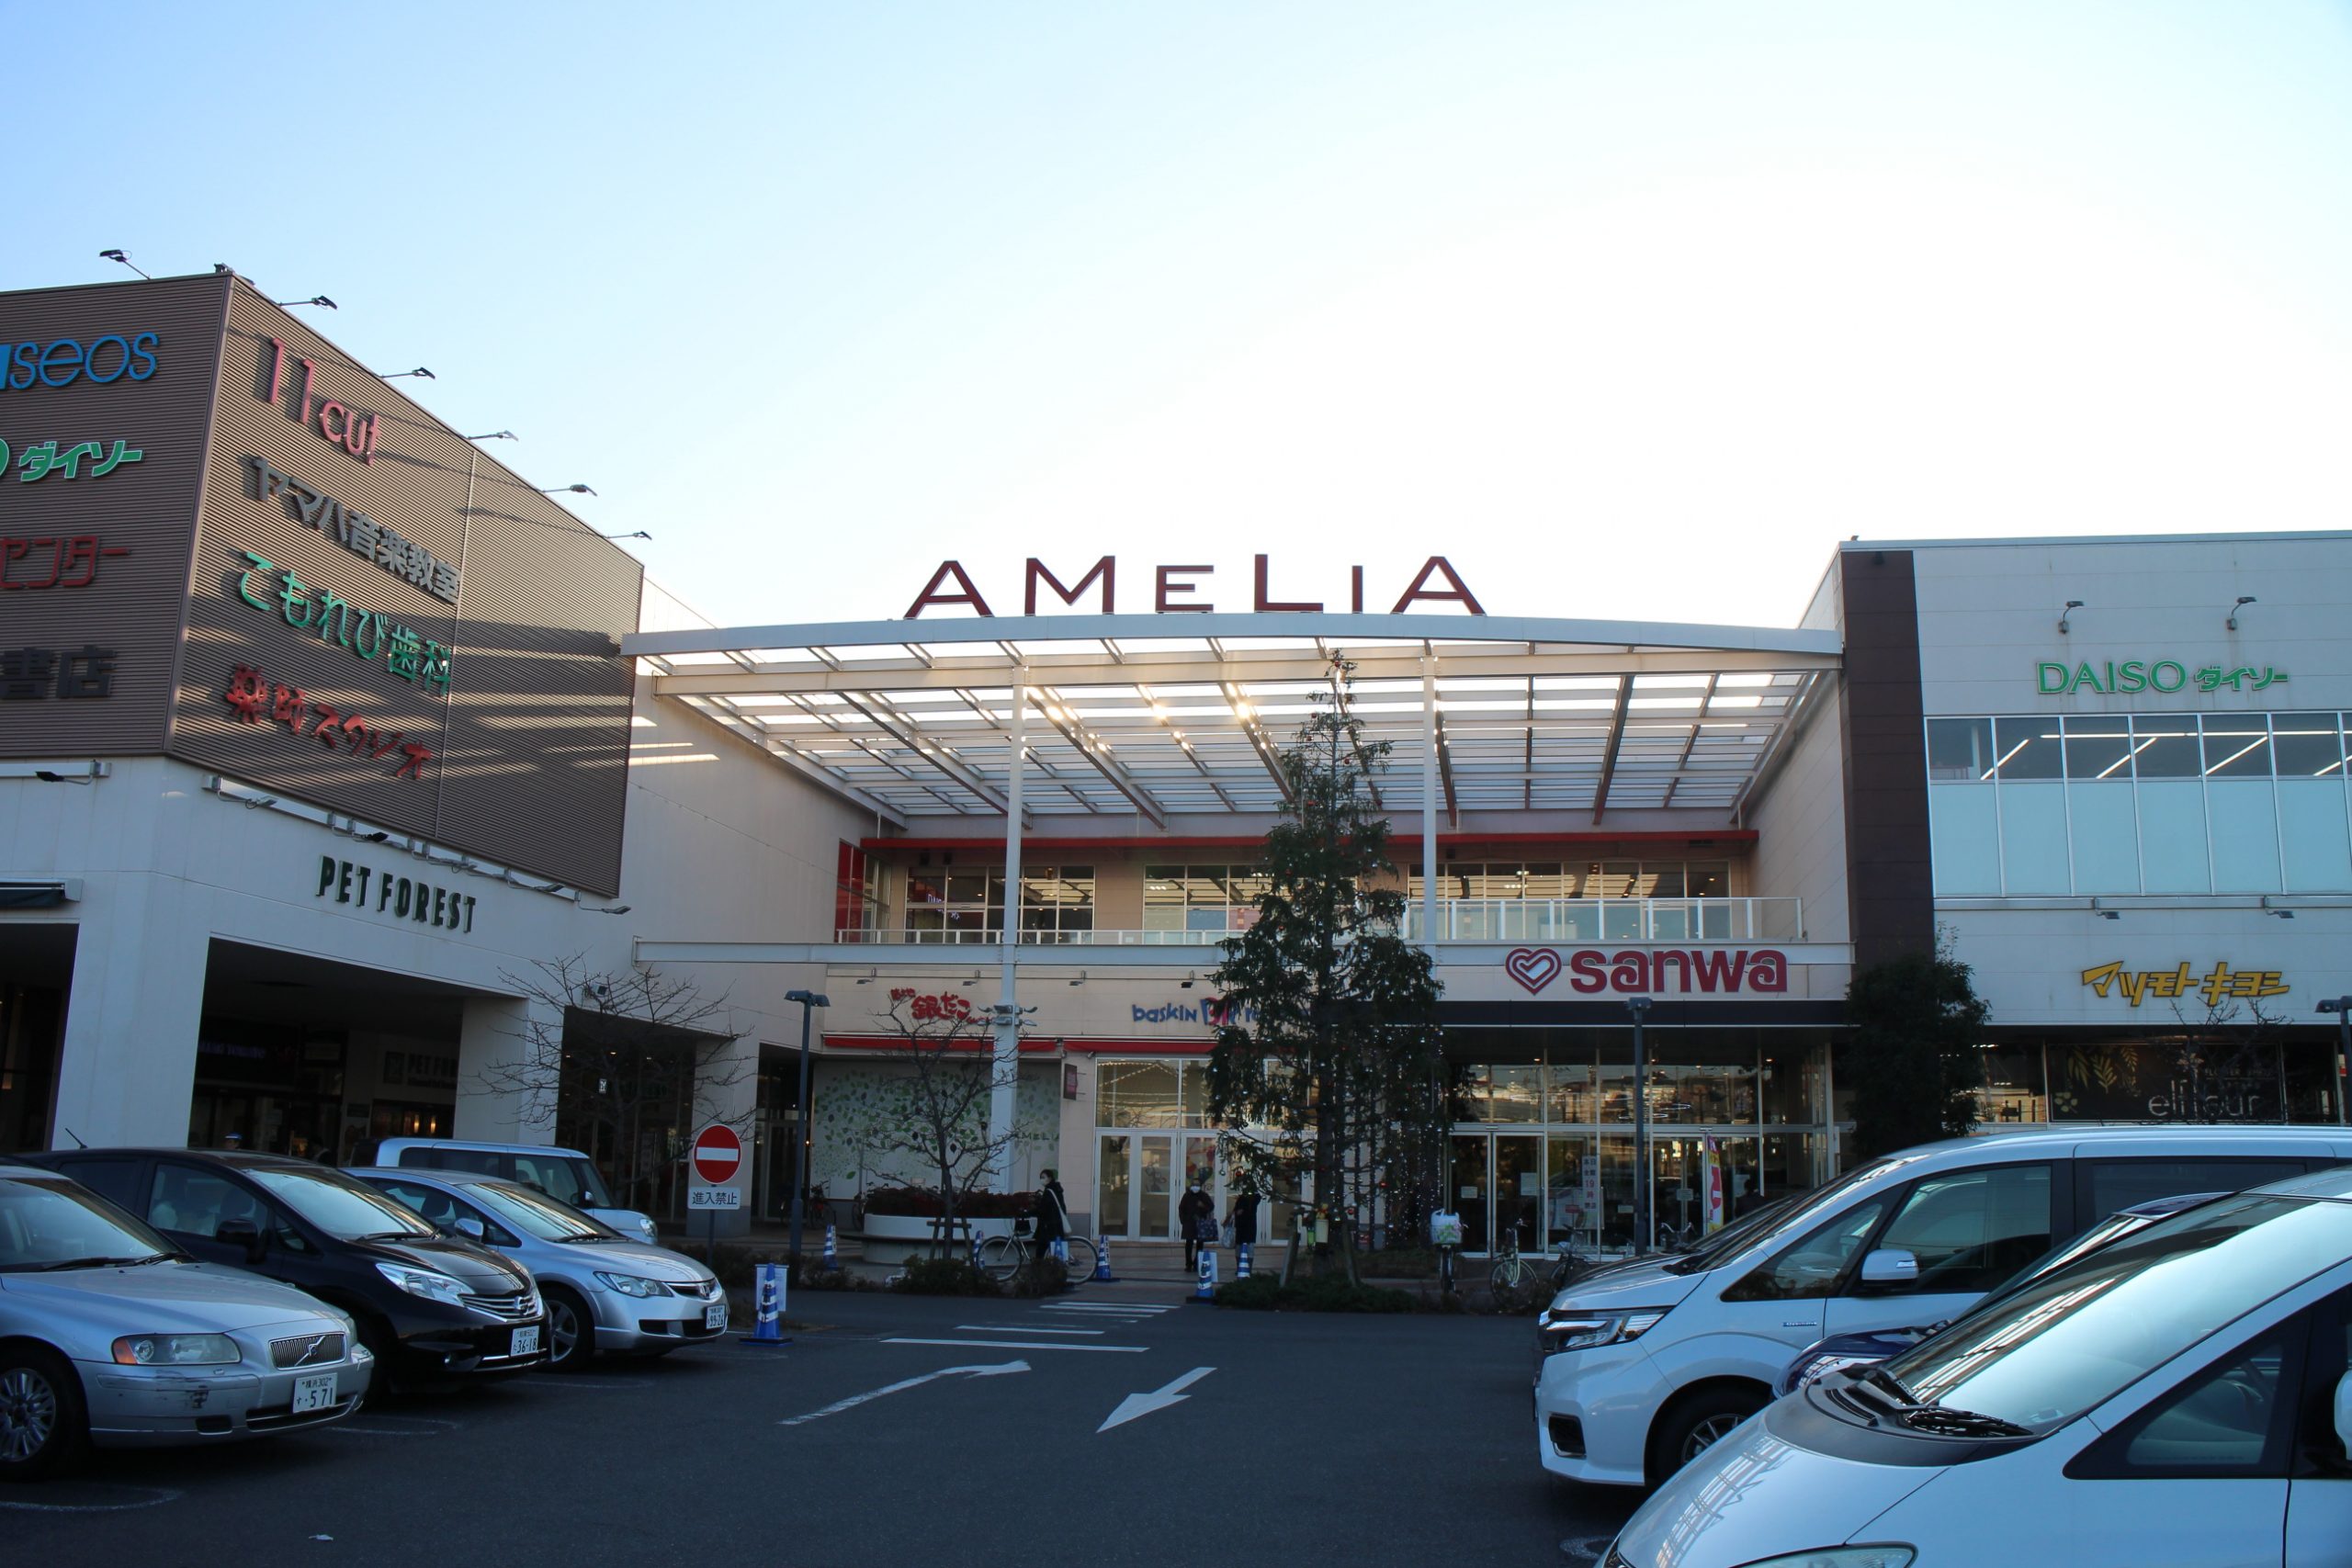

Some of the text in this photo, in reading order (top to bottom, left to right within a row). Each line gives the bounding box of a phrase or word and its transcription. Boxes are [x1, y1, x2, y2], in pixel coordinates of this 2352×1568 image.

[18, 440, 143, 482] ダイソー
[253, 457, 460, 605] ヤマハ音楽教室
[903, 554, 1487, 620] AMELIA
[241, 551, 451, 696] こもれび歯科
[2036, 660, 2289, 694] DAISO ダイソー
[315, 855, 476, 933] PET FOREST
[1570, 950, 1788, 993] sanwa
[2082, 961, 2290, 1007] マツモトキヨシ
[1132, 1003, 1197, 1022] baskin
[692, 1190, 738, 1205] 進入禁止
